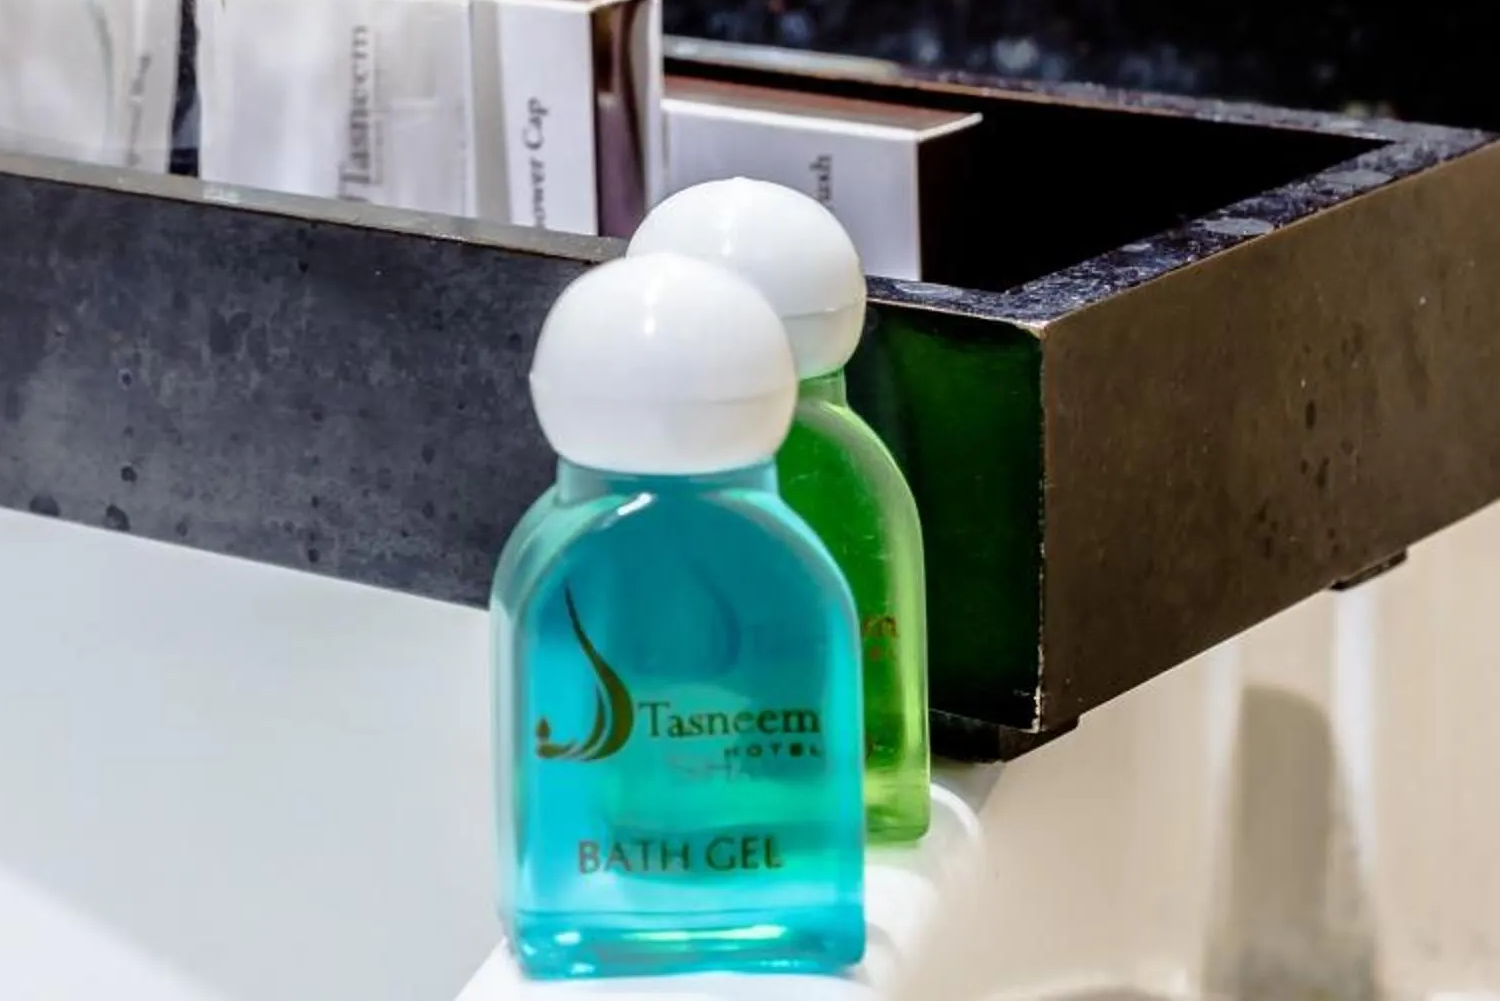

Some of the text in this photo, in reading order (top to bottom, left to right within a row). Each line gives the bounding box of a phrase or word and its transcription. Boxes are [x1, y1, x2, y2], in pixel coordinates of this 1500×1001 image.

[522, 96, 550, 152] Cap
[639, 701, 821, 739] Tasneem
[723, 741, 825, 759] HOTEL
[578, 835, 784, 874] BATH GEL
